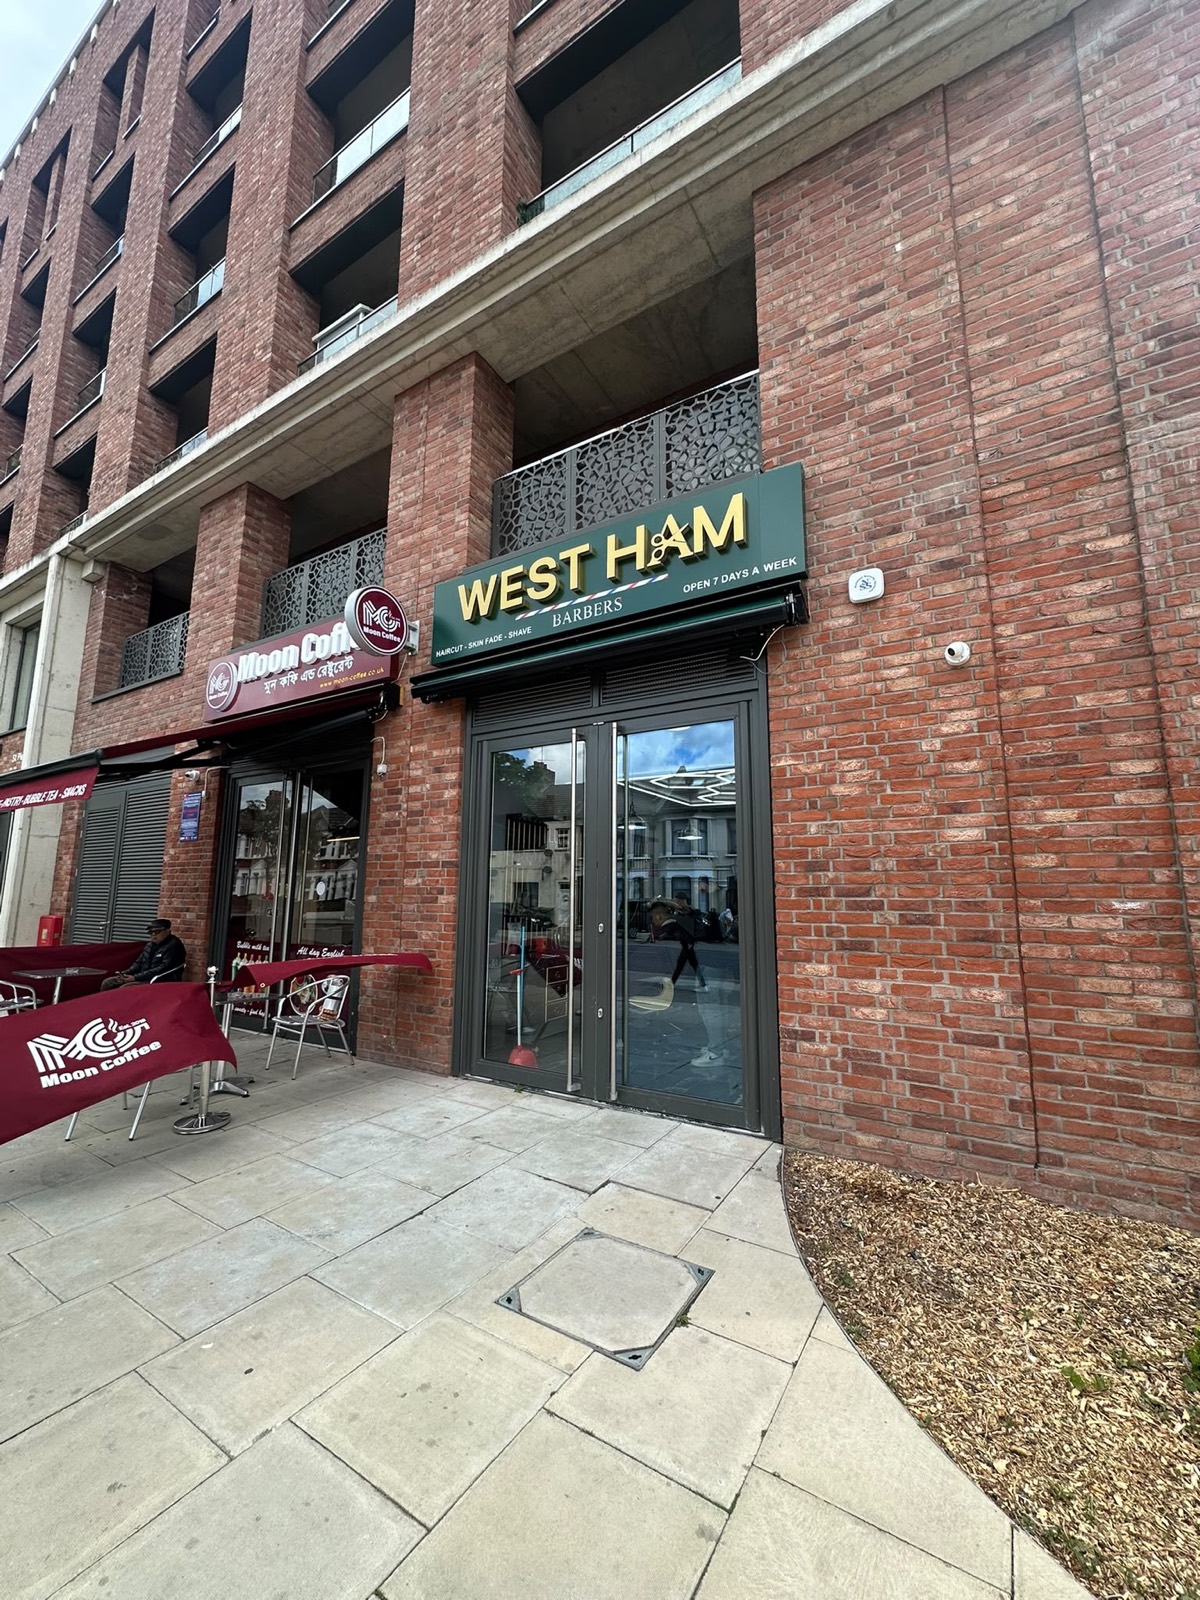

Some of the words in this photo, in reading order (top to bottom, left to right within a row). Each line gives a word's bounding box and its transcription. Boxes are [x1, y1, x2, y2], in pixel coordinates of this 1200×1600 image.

[457, 543, 593, 623] WEST
[606, 492, 747, 582] HAM
[682, 577, 711, 594] OPEN
[712, 575, 720, 586] 7
[720, 571, 750, 585] DAYS
[751, 566, 760, 575] A
[763, 556, 798, 573] WEEK
[552, 597, 623, 628] BARBERS
[363, 626, 381, 638] Moon
[381, 631, 401, 643] Coffee
[435, 644, 463, 658] HAIRCUT
[468, 639, 484, 650] SKIN
[485, 633, 503, 645] FADE
[508, 626, 532, 639] SHAVE
[237, 643, 300, 683] Moon
[301, 621, 360, 665] Coff
[46, 789, 59, 801] TEA
[61, 783, 87, 800] SNACKS
[296, 946, 309, 955] All
[308, 948, 320, 958] day
[39, 1065, 99, 1088] Moon
[100, 1040, 162, 1071] Coffee
